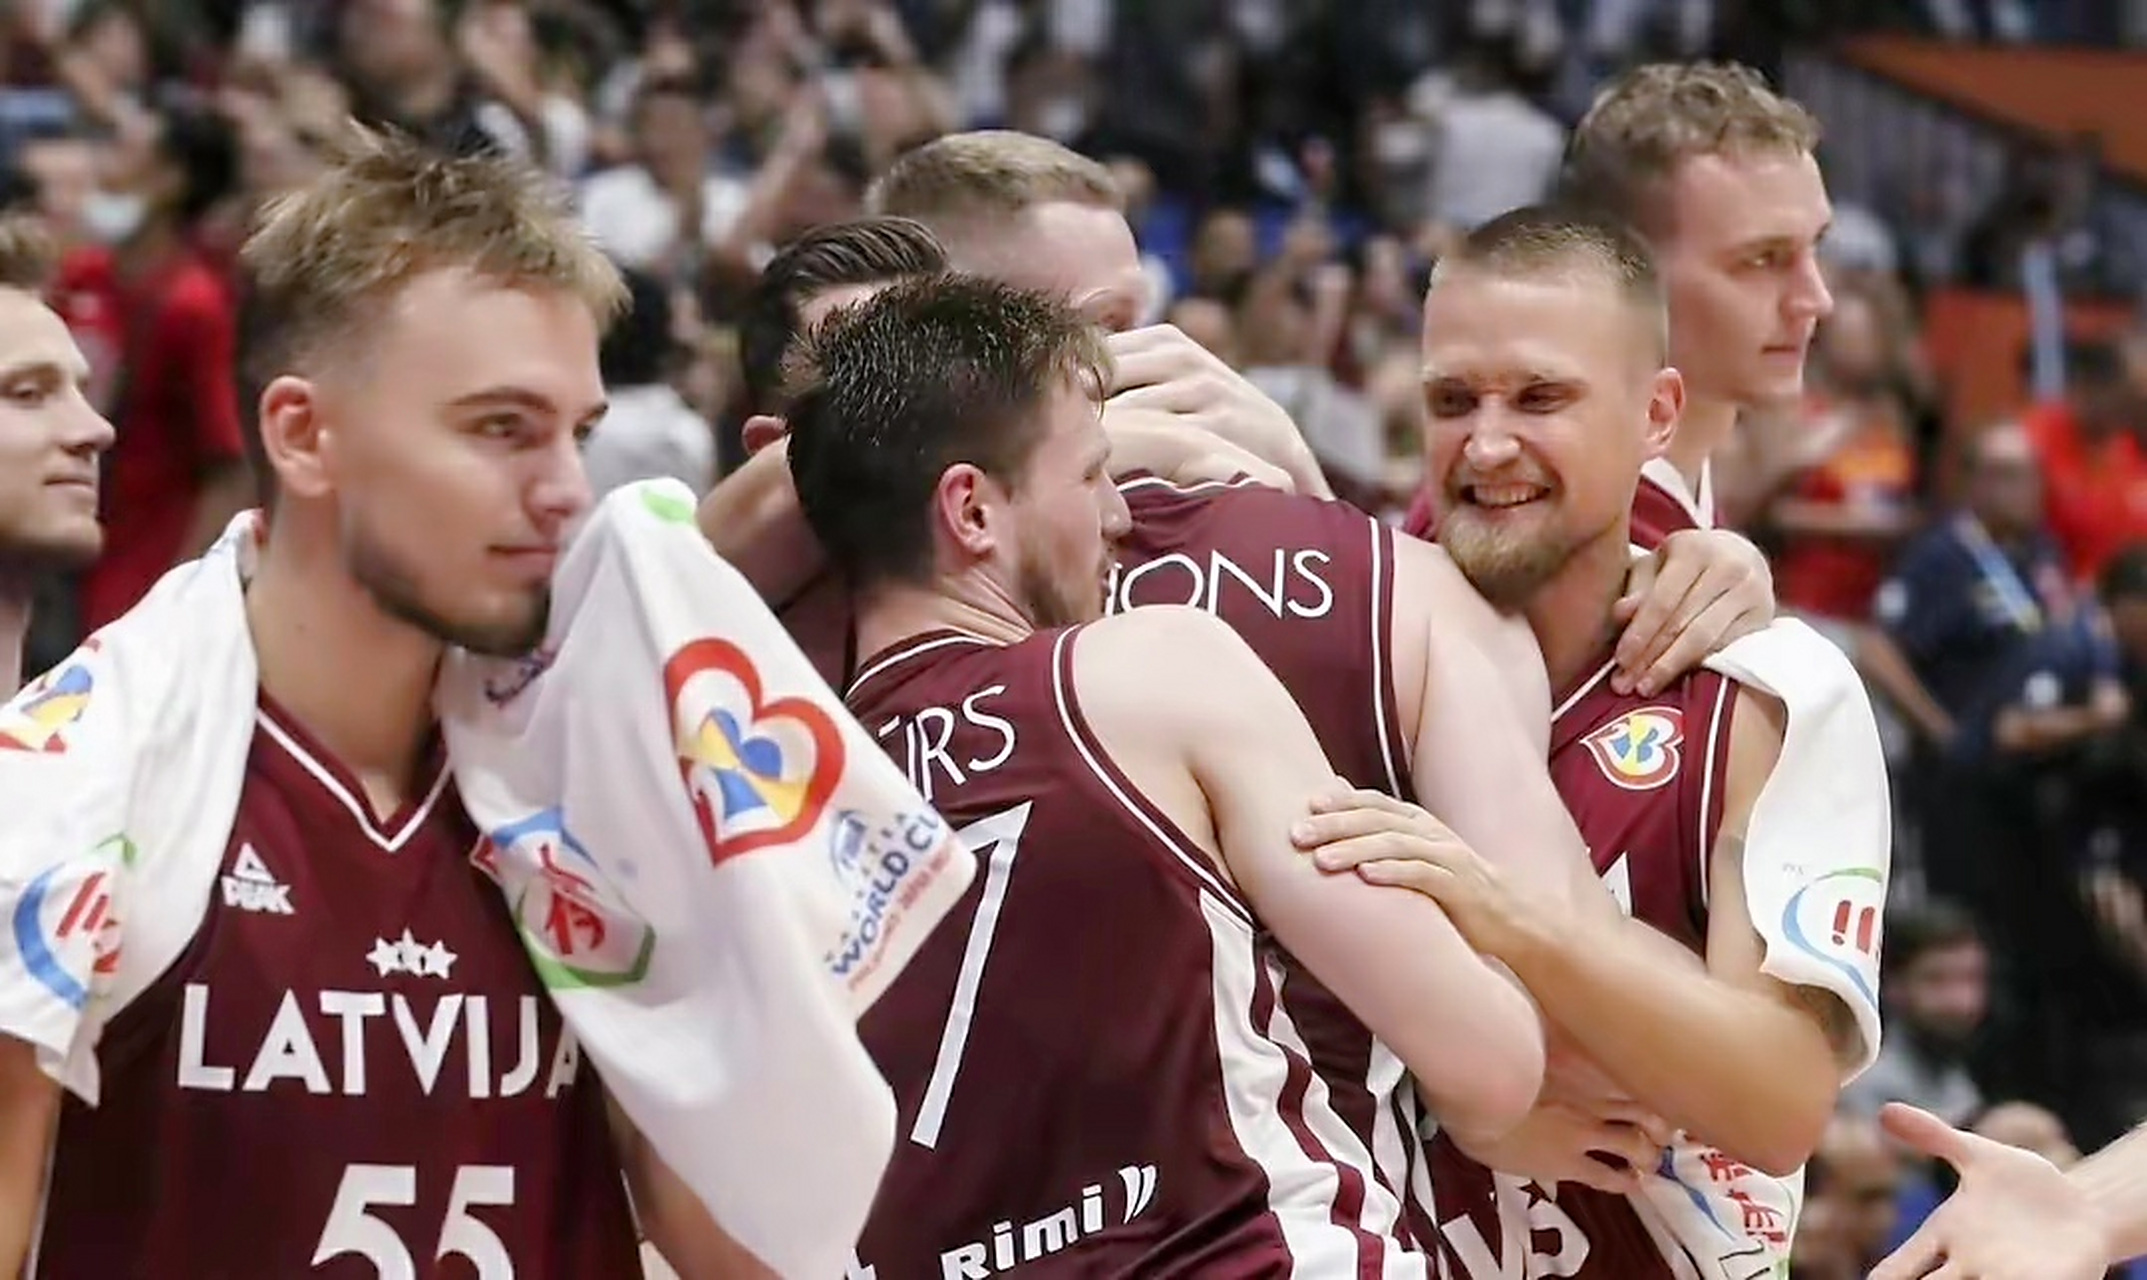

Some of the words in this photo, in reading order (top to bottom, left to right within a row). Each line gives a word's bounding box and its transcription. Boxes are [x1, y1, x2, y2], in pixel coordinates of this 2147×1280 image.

[832, 851, 909, 974] WORLD
[910, 800, 1033, 1149] 7
[311, 1163, 515, 1280] 55
[940, 1184, 1103, 1280] Rimi
